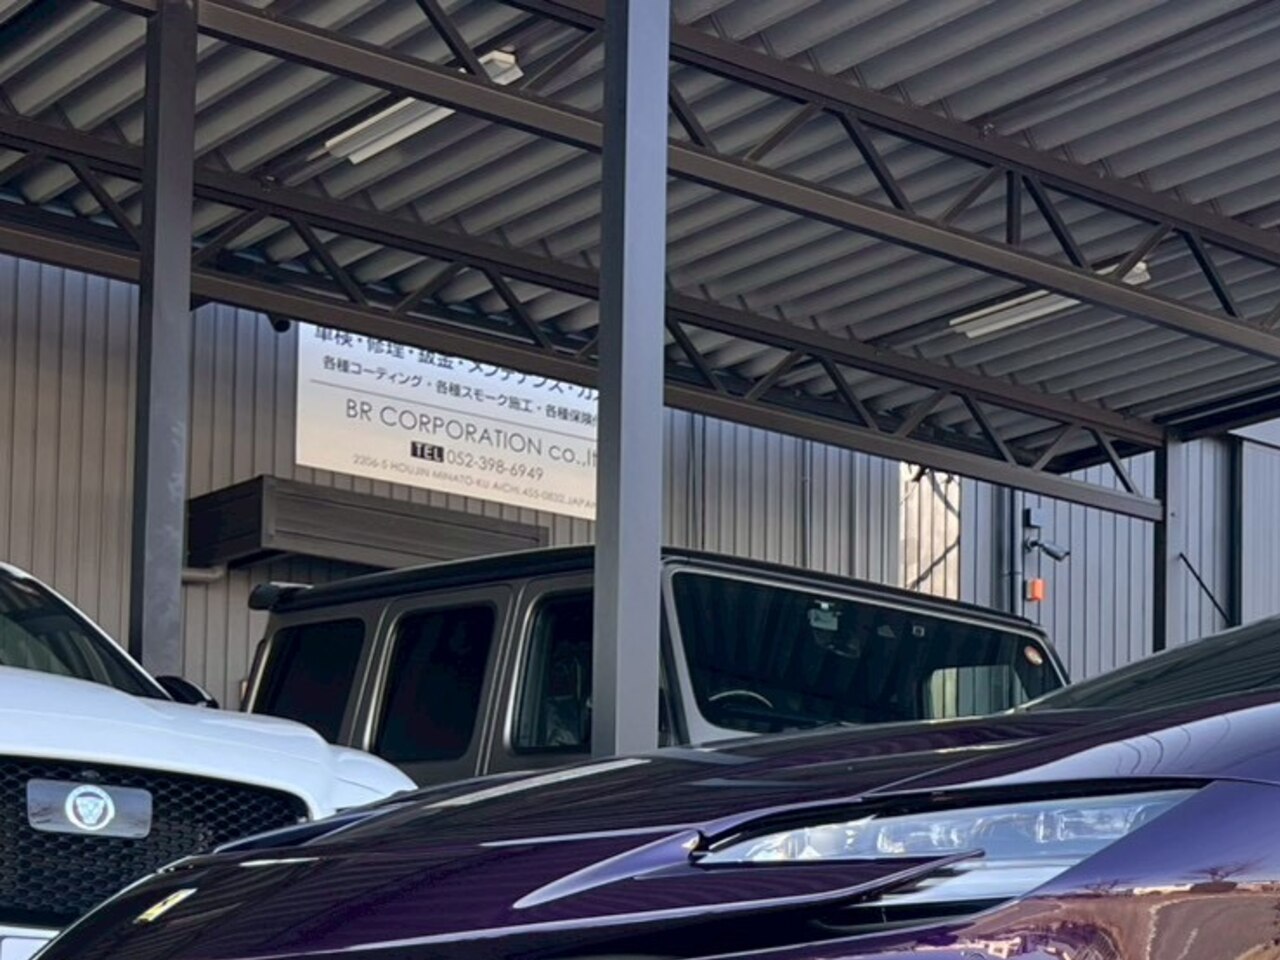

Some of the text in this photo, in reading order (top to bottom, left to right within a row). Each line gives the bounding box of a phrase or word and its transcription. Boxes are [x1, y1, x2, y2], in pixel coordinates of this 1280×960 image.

[346, 398, 597, 468] BR CORPORATION co.,lt
[411, 441, 544, 480] TEL 052-398-6949
